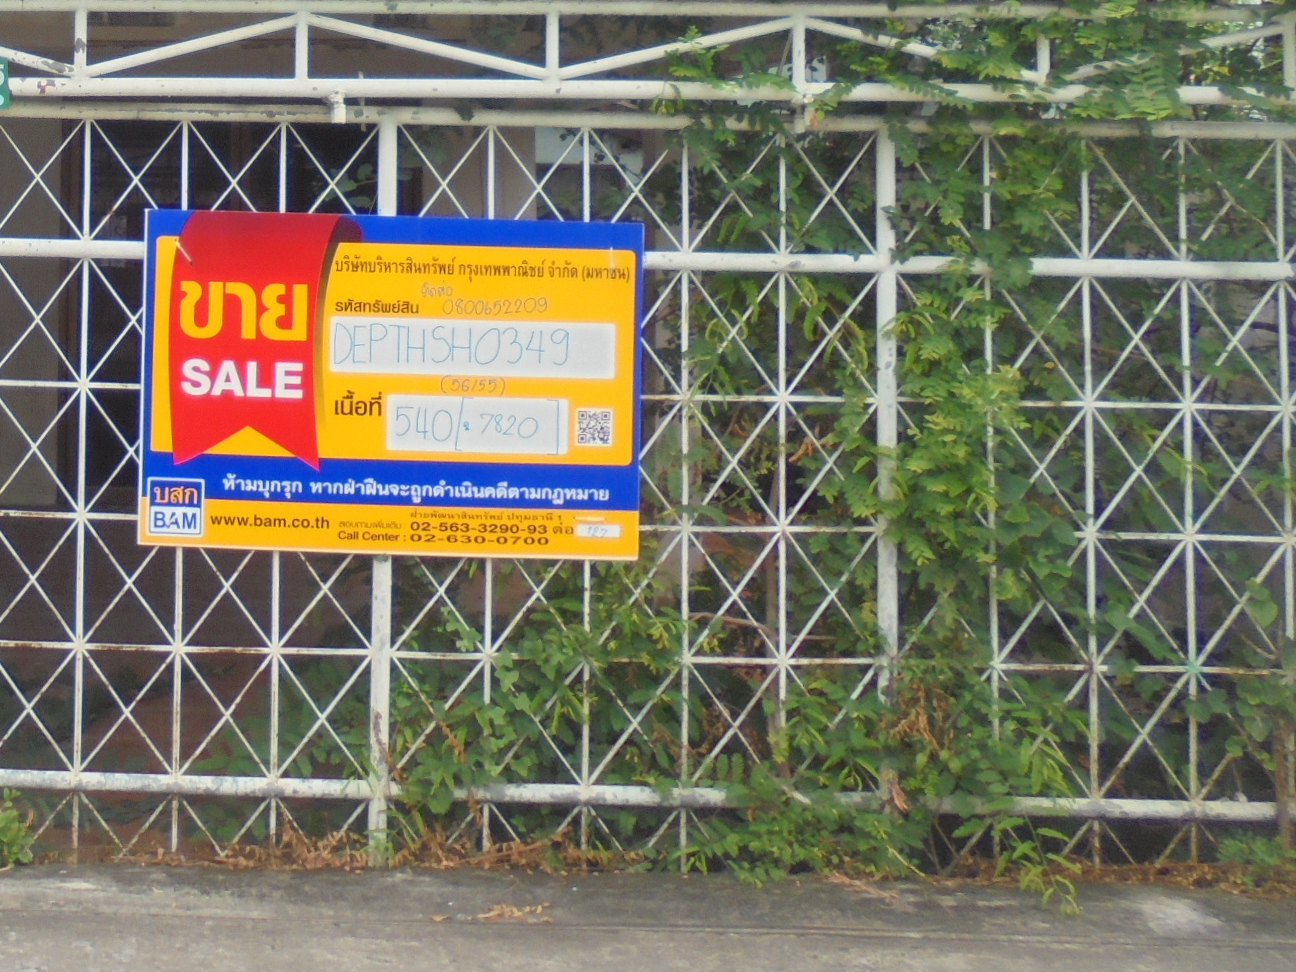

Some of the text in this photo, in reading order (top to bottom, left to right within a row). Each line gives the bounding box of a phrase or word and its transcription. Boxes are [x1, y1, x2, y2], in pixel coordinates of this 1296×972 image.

[335, 255, 630, 282] บริษัทบริหารสินทรัพย์ กรุงเทพพาณิชย์ จำกัด (มหาชน)
[179, 281, 309, 341] ขาย
[334, 298, 420, 316] รหัสทรัพย์สิน
[442, 297, 548, 316] 0800652209
[181, 358, 304, 399] SALE
[334, 390, 383, 417] เนื้อที่
[153, 486, 198, 505] บสก
[222, 473, 610, 505] ห้ามบุกรุก หากฝ่าฝืนจะถูกดำเนินคดีตามกฎหมาย
[153, 511, 198, 530] BAM
[210, 514, 330, 529] www.bam.co.th
[410, 521, 548, 535] 02-563-3290-93
[338, 530, 359, 541] Call
[362, 531, 400, 542] Center
[410, 532, 549, 546] 02-630-0700
